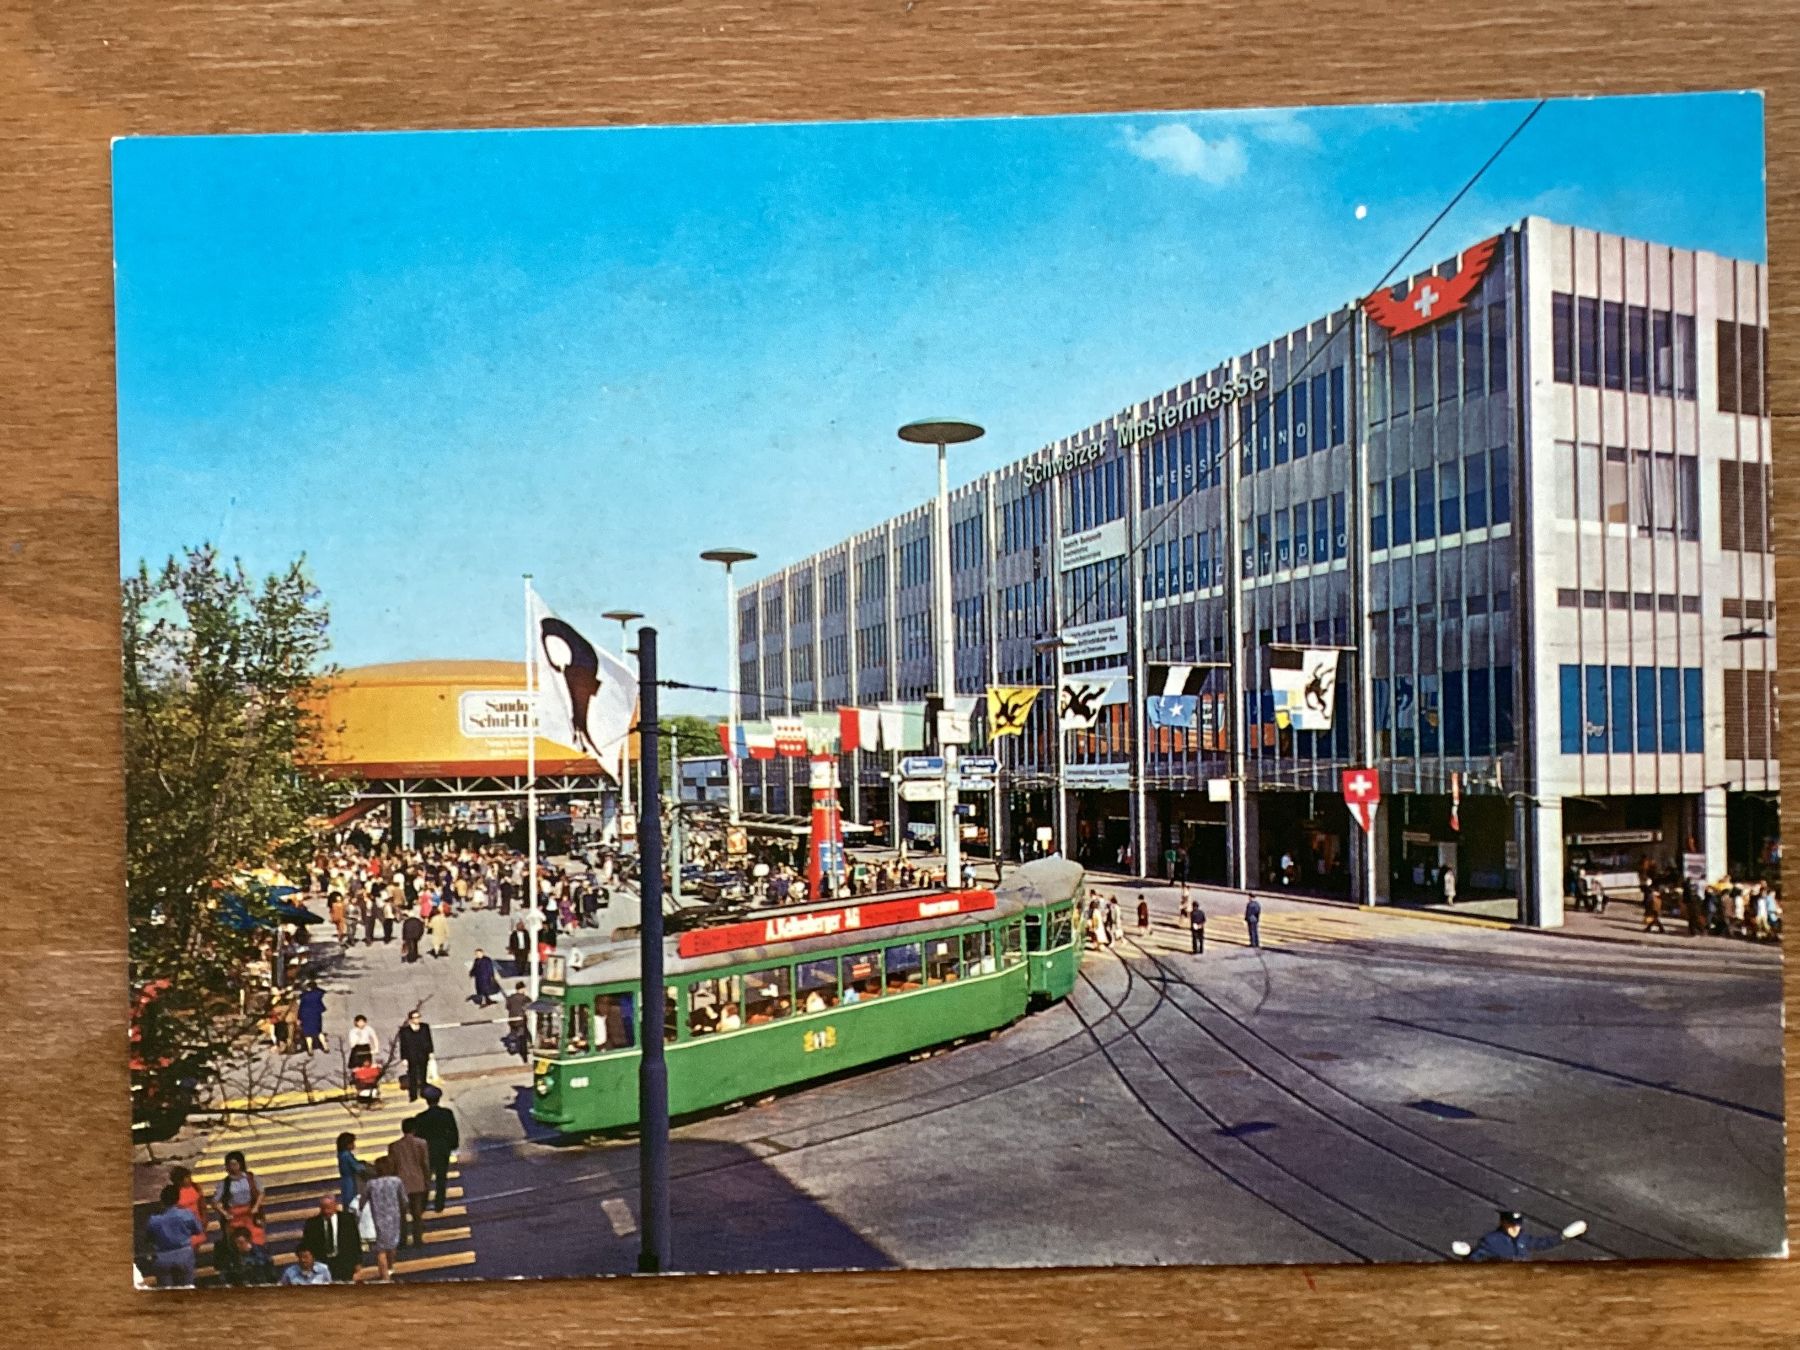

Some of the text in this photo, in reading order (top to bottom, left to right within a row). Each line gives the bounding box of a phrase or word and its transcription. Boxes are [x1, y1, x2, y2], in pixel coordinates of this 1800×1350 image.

[1023, 366, 1268, 487] Schweizer Mustermesse
[1243, 422, 1306, 458] KINO
[1245, 533, 1348, 570] STUDIO
